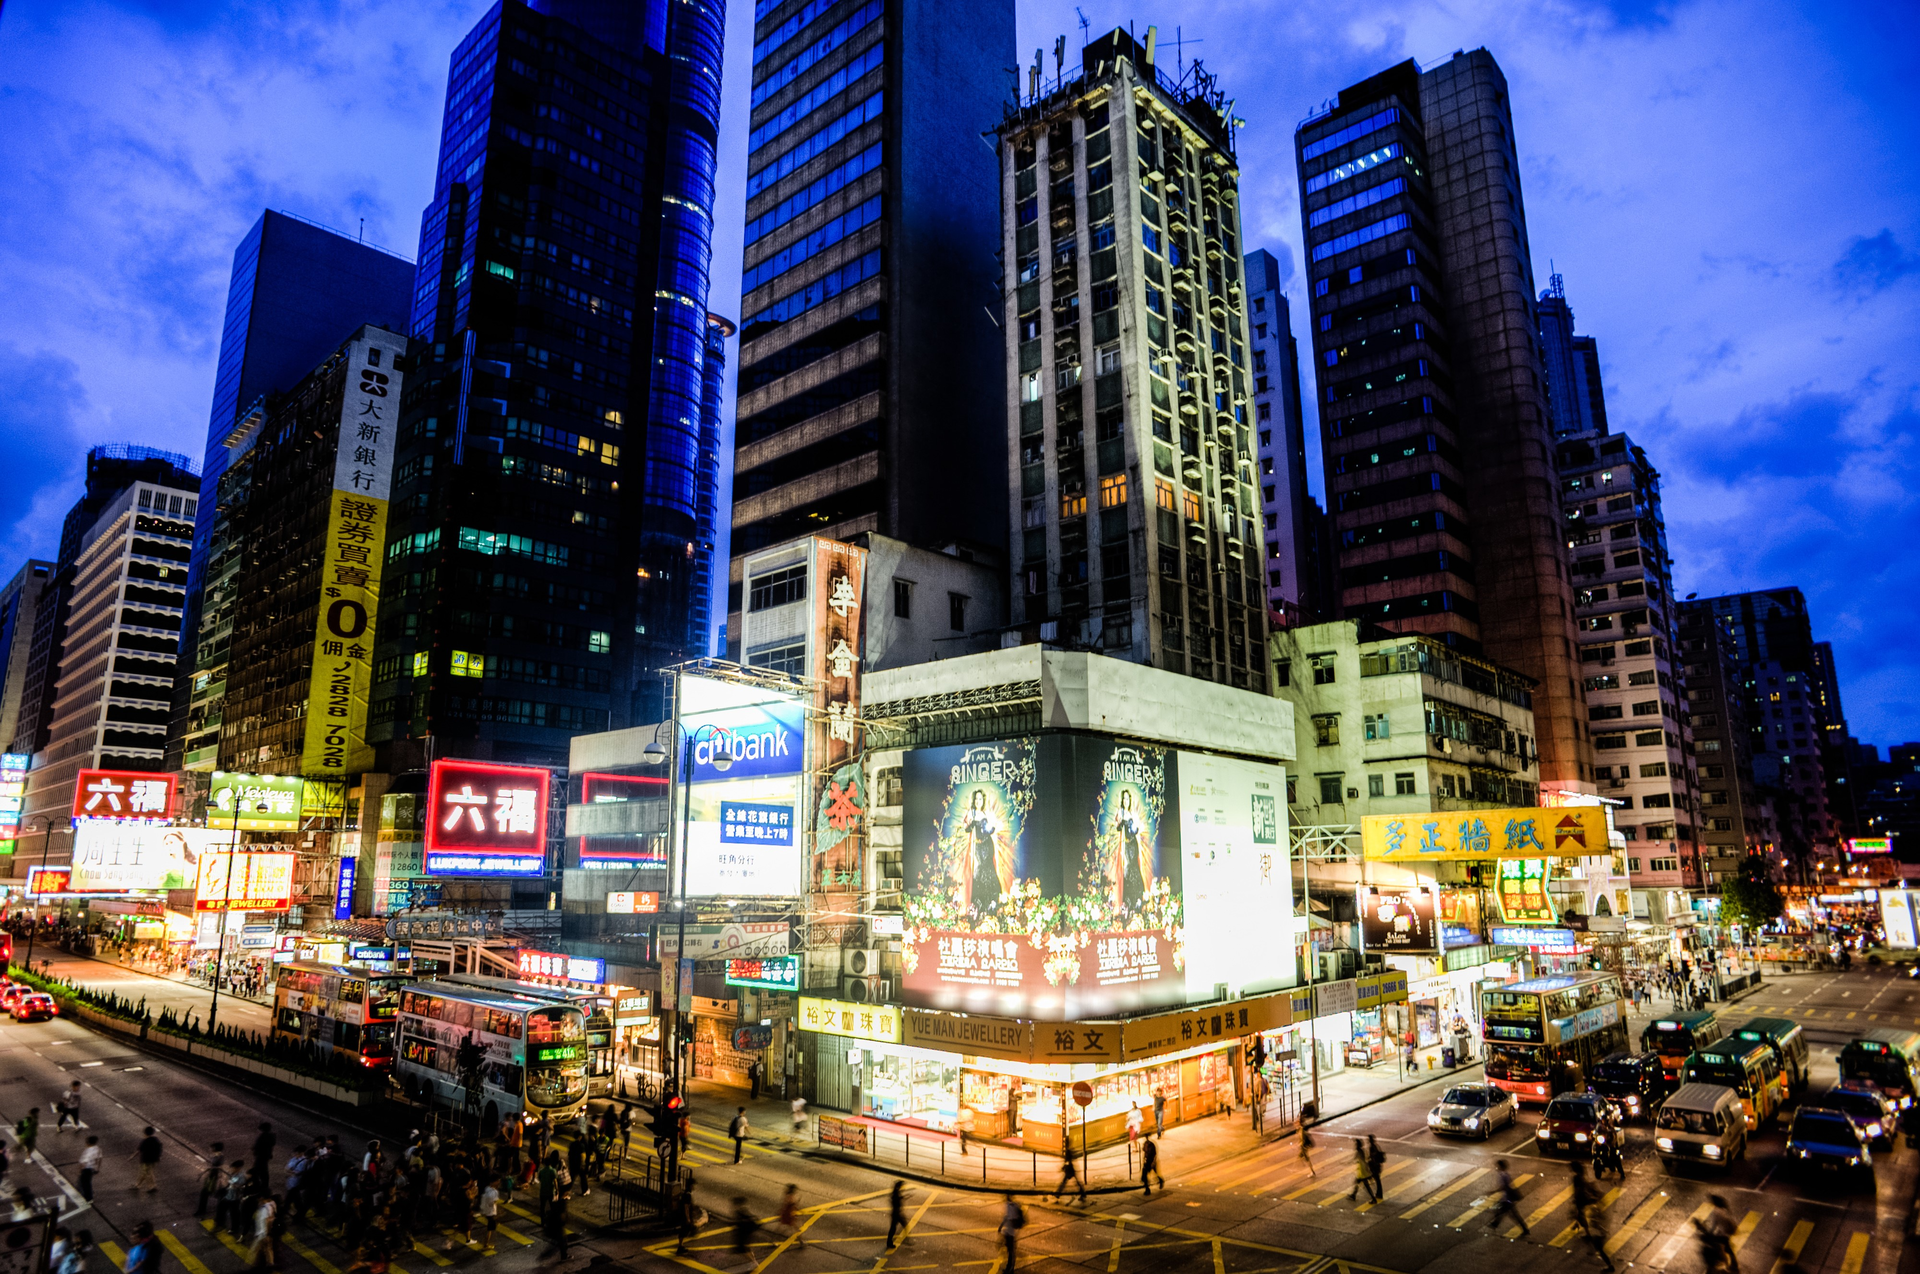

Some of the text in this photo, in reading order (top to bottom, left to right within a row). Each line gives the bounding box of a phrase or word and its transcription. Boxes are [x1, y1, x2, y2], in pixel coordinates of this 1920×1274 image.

[351, 399, 383, 490] 大新銀行
[331, 497, 378, 589] 證券買賣
[321, 639, 368, 660] 佣金
[694, 723, 789, 766] citibank
[975, 753, 986, 761] AM
[986, 752, 993, 760] A
[950, 759, 1019, 785] SINGER
[1104, 760, 1154, 786] SINGER
[84, 778, 168, 813] 六福
[443, 785, 537, 834] 六福
[824, 781, 863, 831] 茶
[81, 836, 144, 865] 周生生
[1383, 818, 1544, 856] 多正牆紙
[80, 868, 101, 879] Chow
[339, 868, 352, 908] 花旗銀行
[228, 899, 278, 909] JEWELLERY
[911, 1016, 1023, 1047] YUE MAN JEWELLERY
[1054, 1029, 1104, 1051] 裕文
